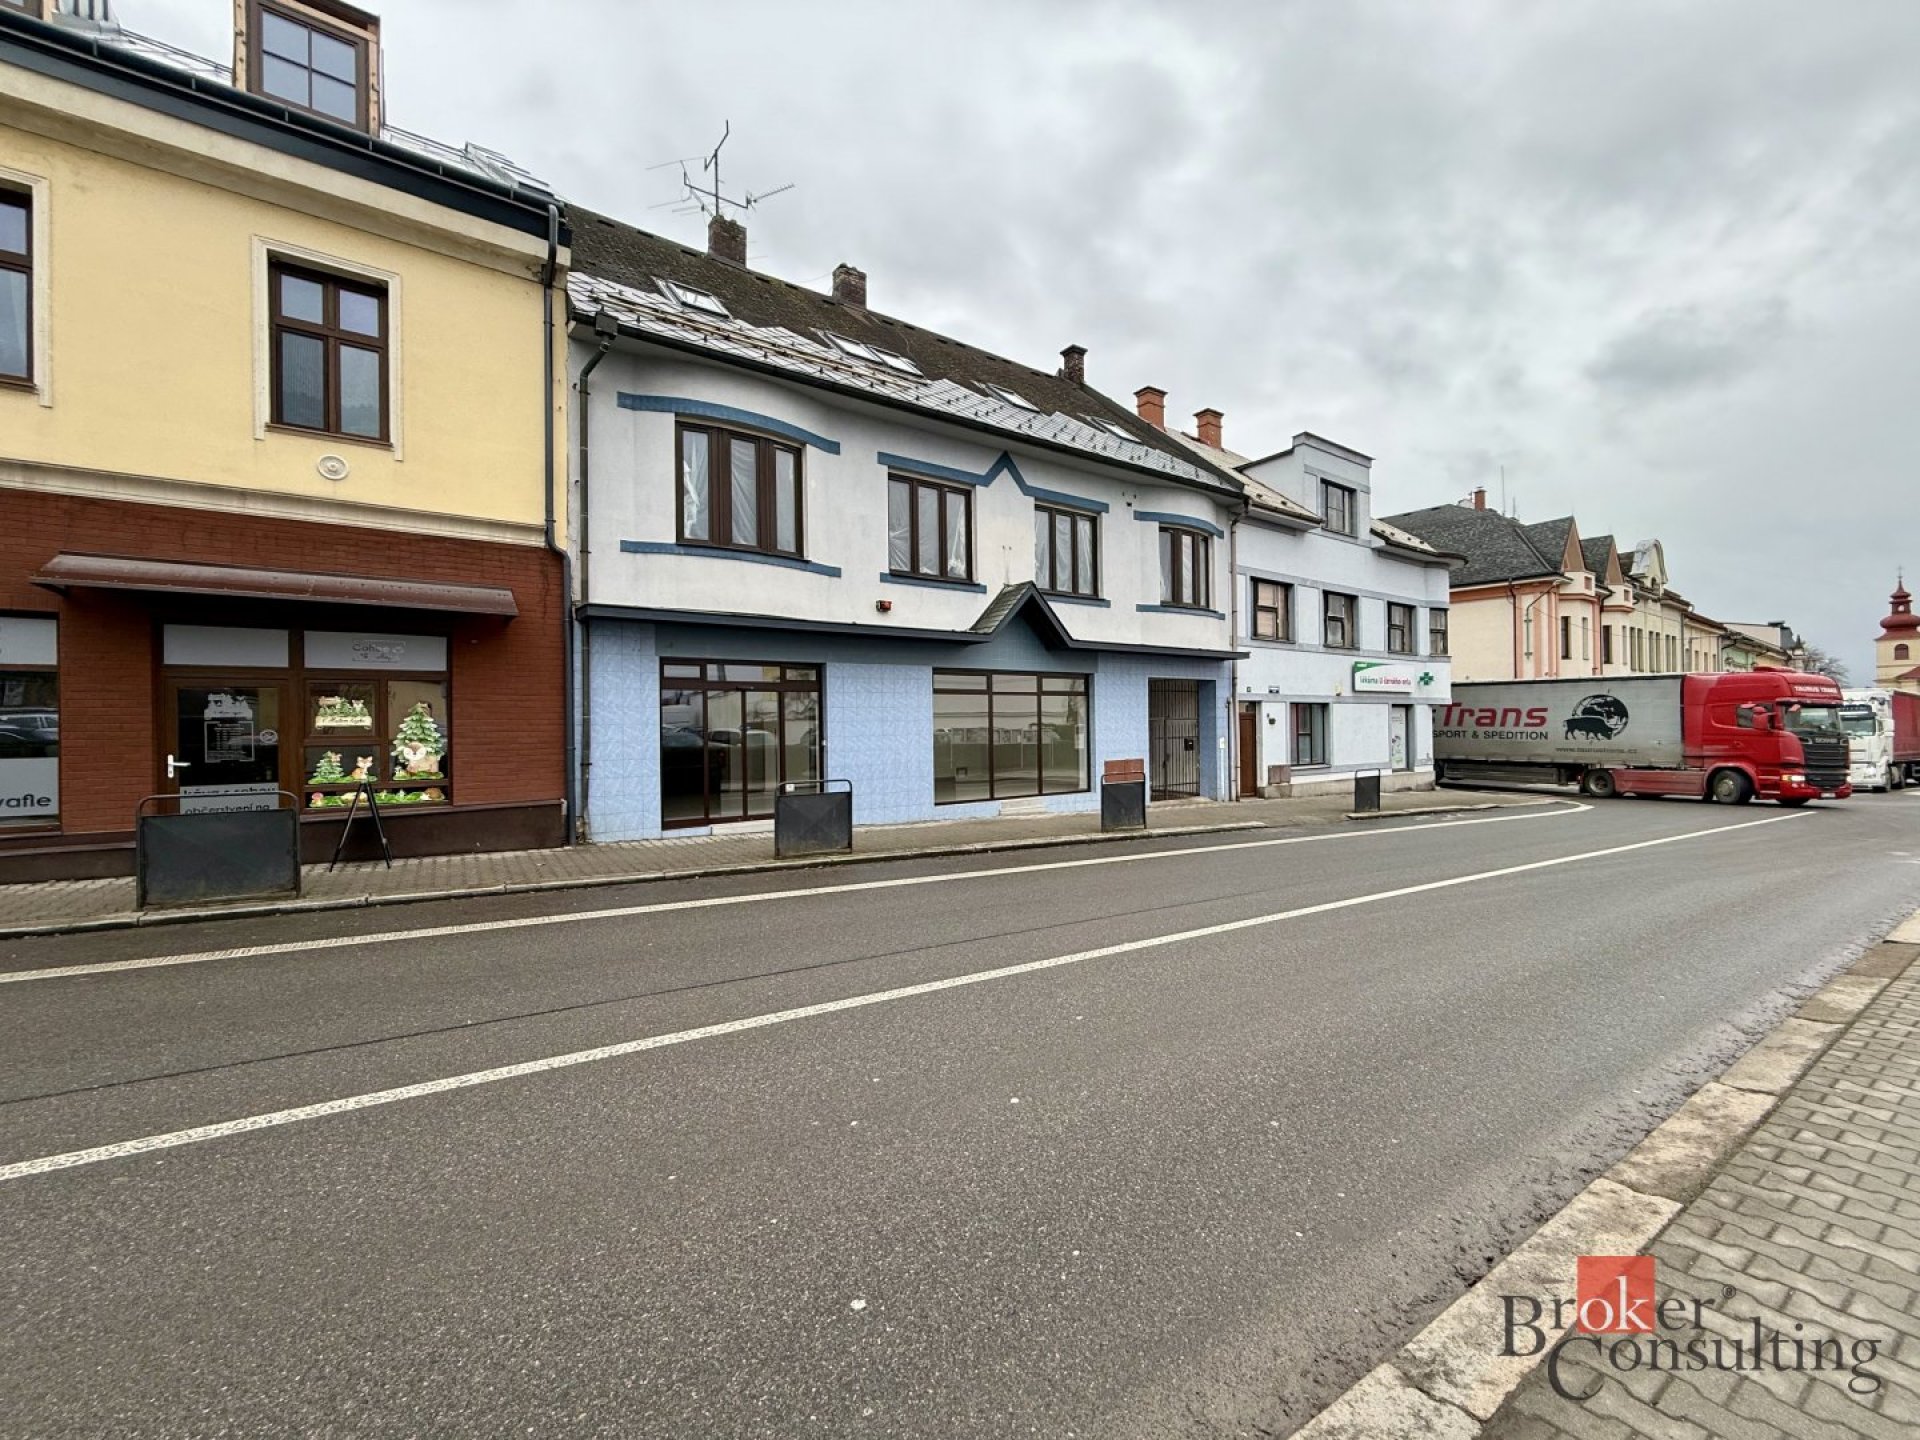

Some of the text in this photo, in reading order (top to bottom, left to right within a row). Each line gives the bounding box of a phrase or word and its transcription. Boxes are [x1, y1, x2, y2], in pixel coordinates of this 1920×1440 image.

[1439, 702, 1549, 728] Trans
[1471, 731, 1480, 740] &
[1483, 731, 1549, 741] SPEDITION
